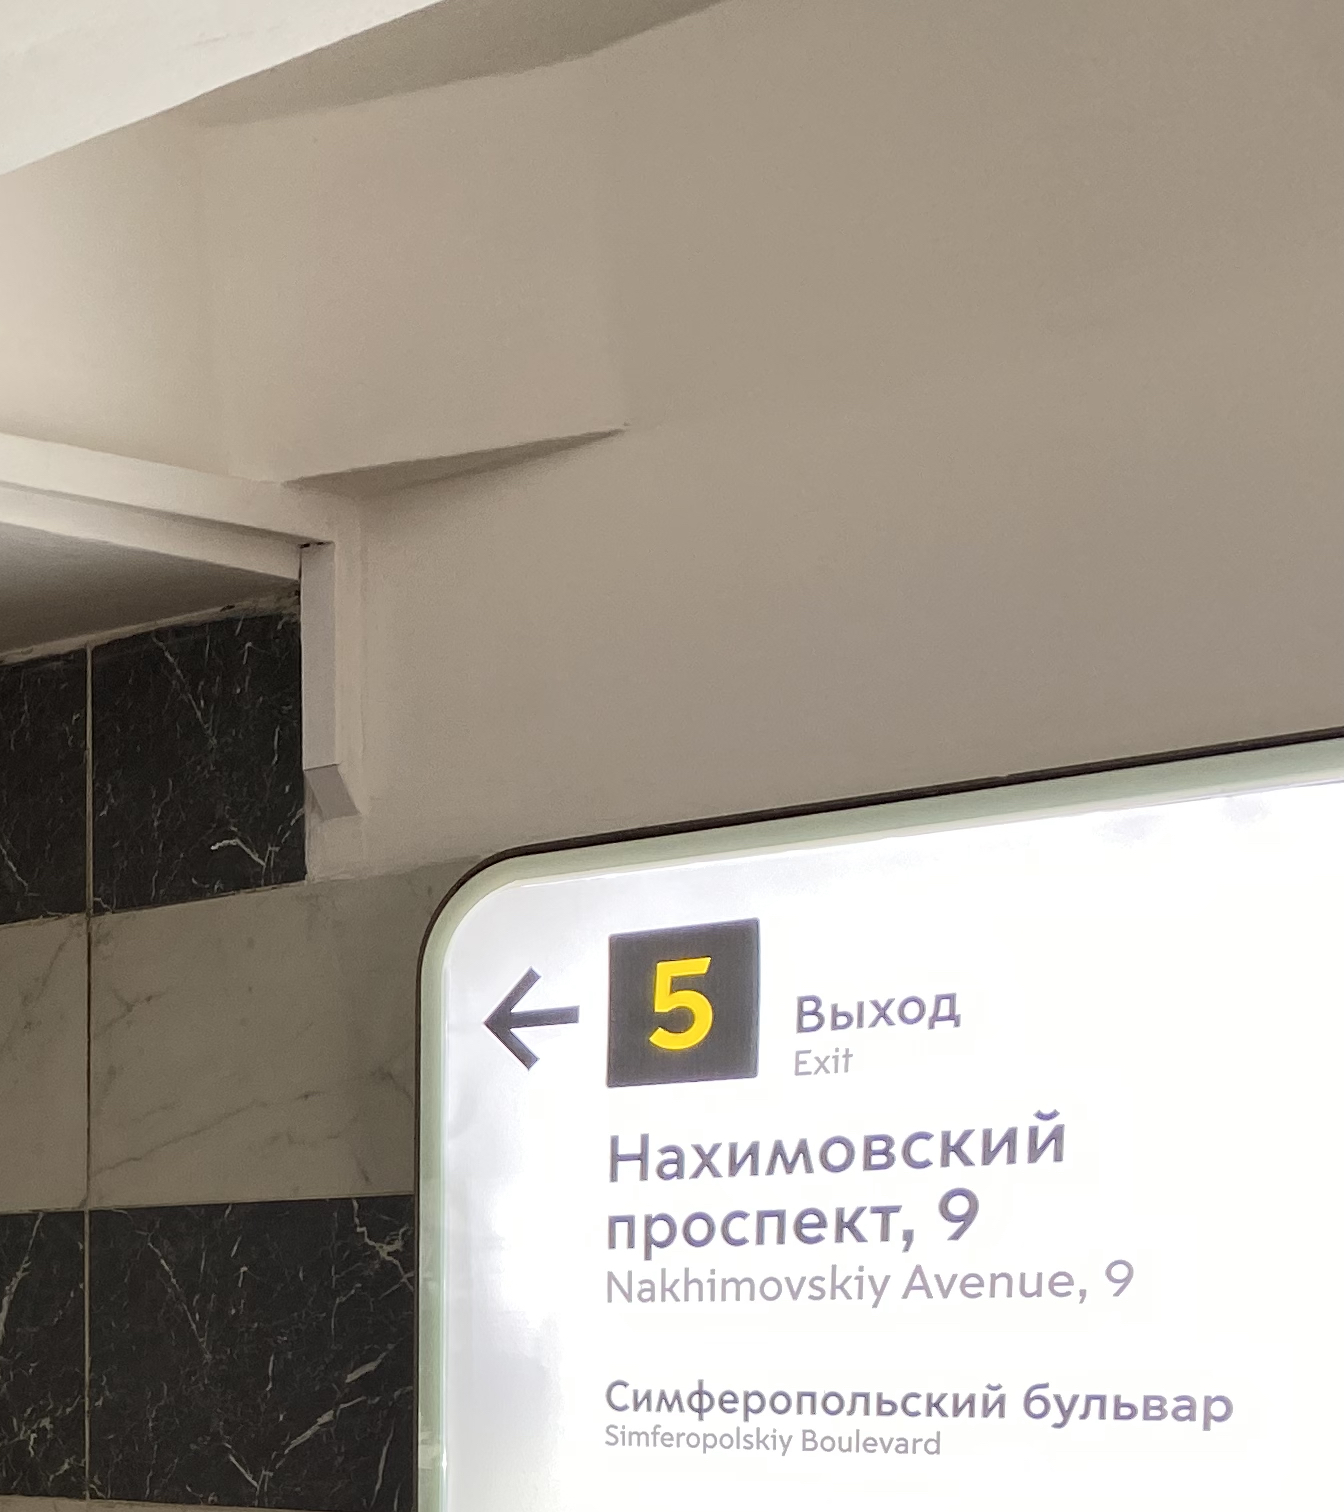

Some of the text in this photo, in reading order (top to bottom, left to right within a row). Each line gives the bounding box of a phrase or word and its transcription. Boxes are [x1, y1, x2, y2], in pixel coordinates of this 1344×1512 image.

[649, 956, 714, 1050] 5
[796, 992, 961, 1034] Выход
[794, 1047, 854, 1076] Exit
[609, 1109, 1065, 1183] Нахимовский
[607, 1187, 981, 1261] проспект, 9
[606, 1259, 1135, 1309] Nakhimovskiy Avenue, 9
[605, 1378, 1234, 1432] Симферопольский бульвар
[604, 1423, 941, 1457] Simferopolskiy Boulevard
